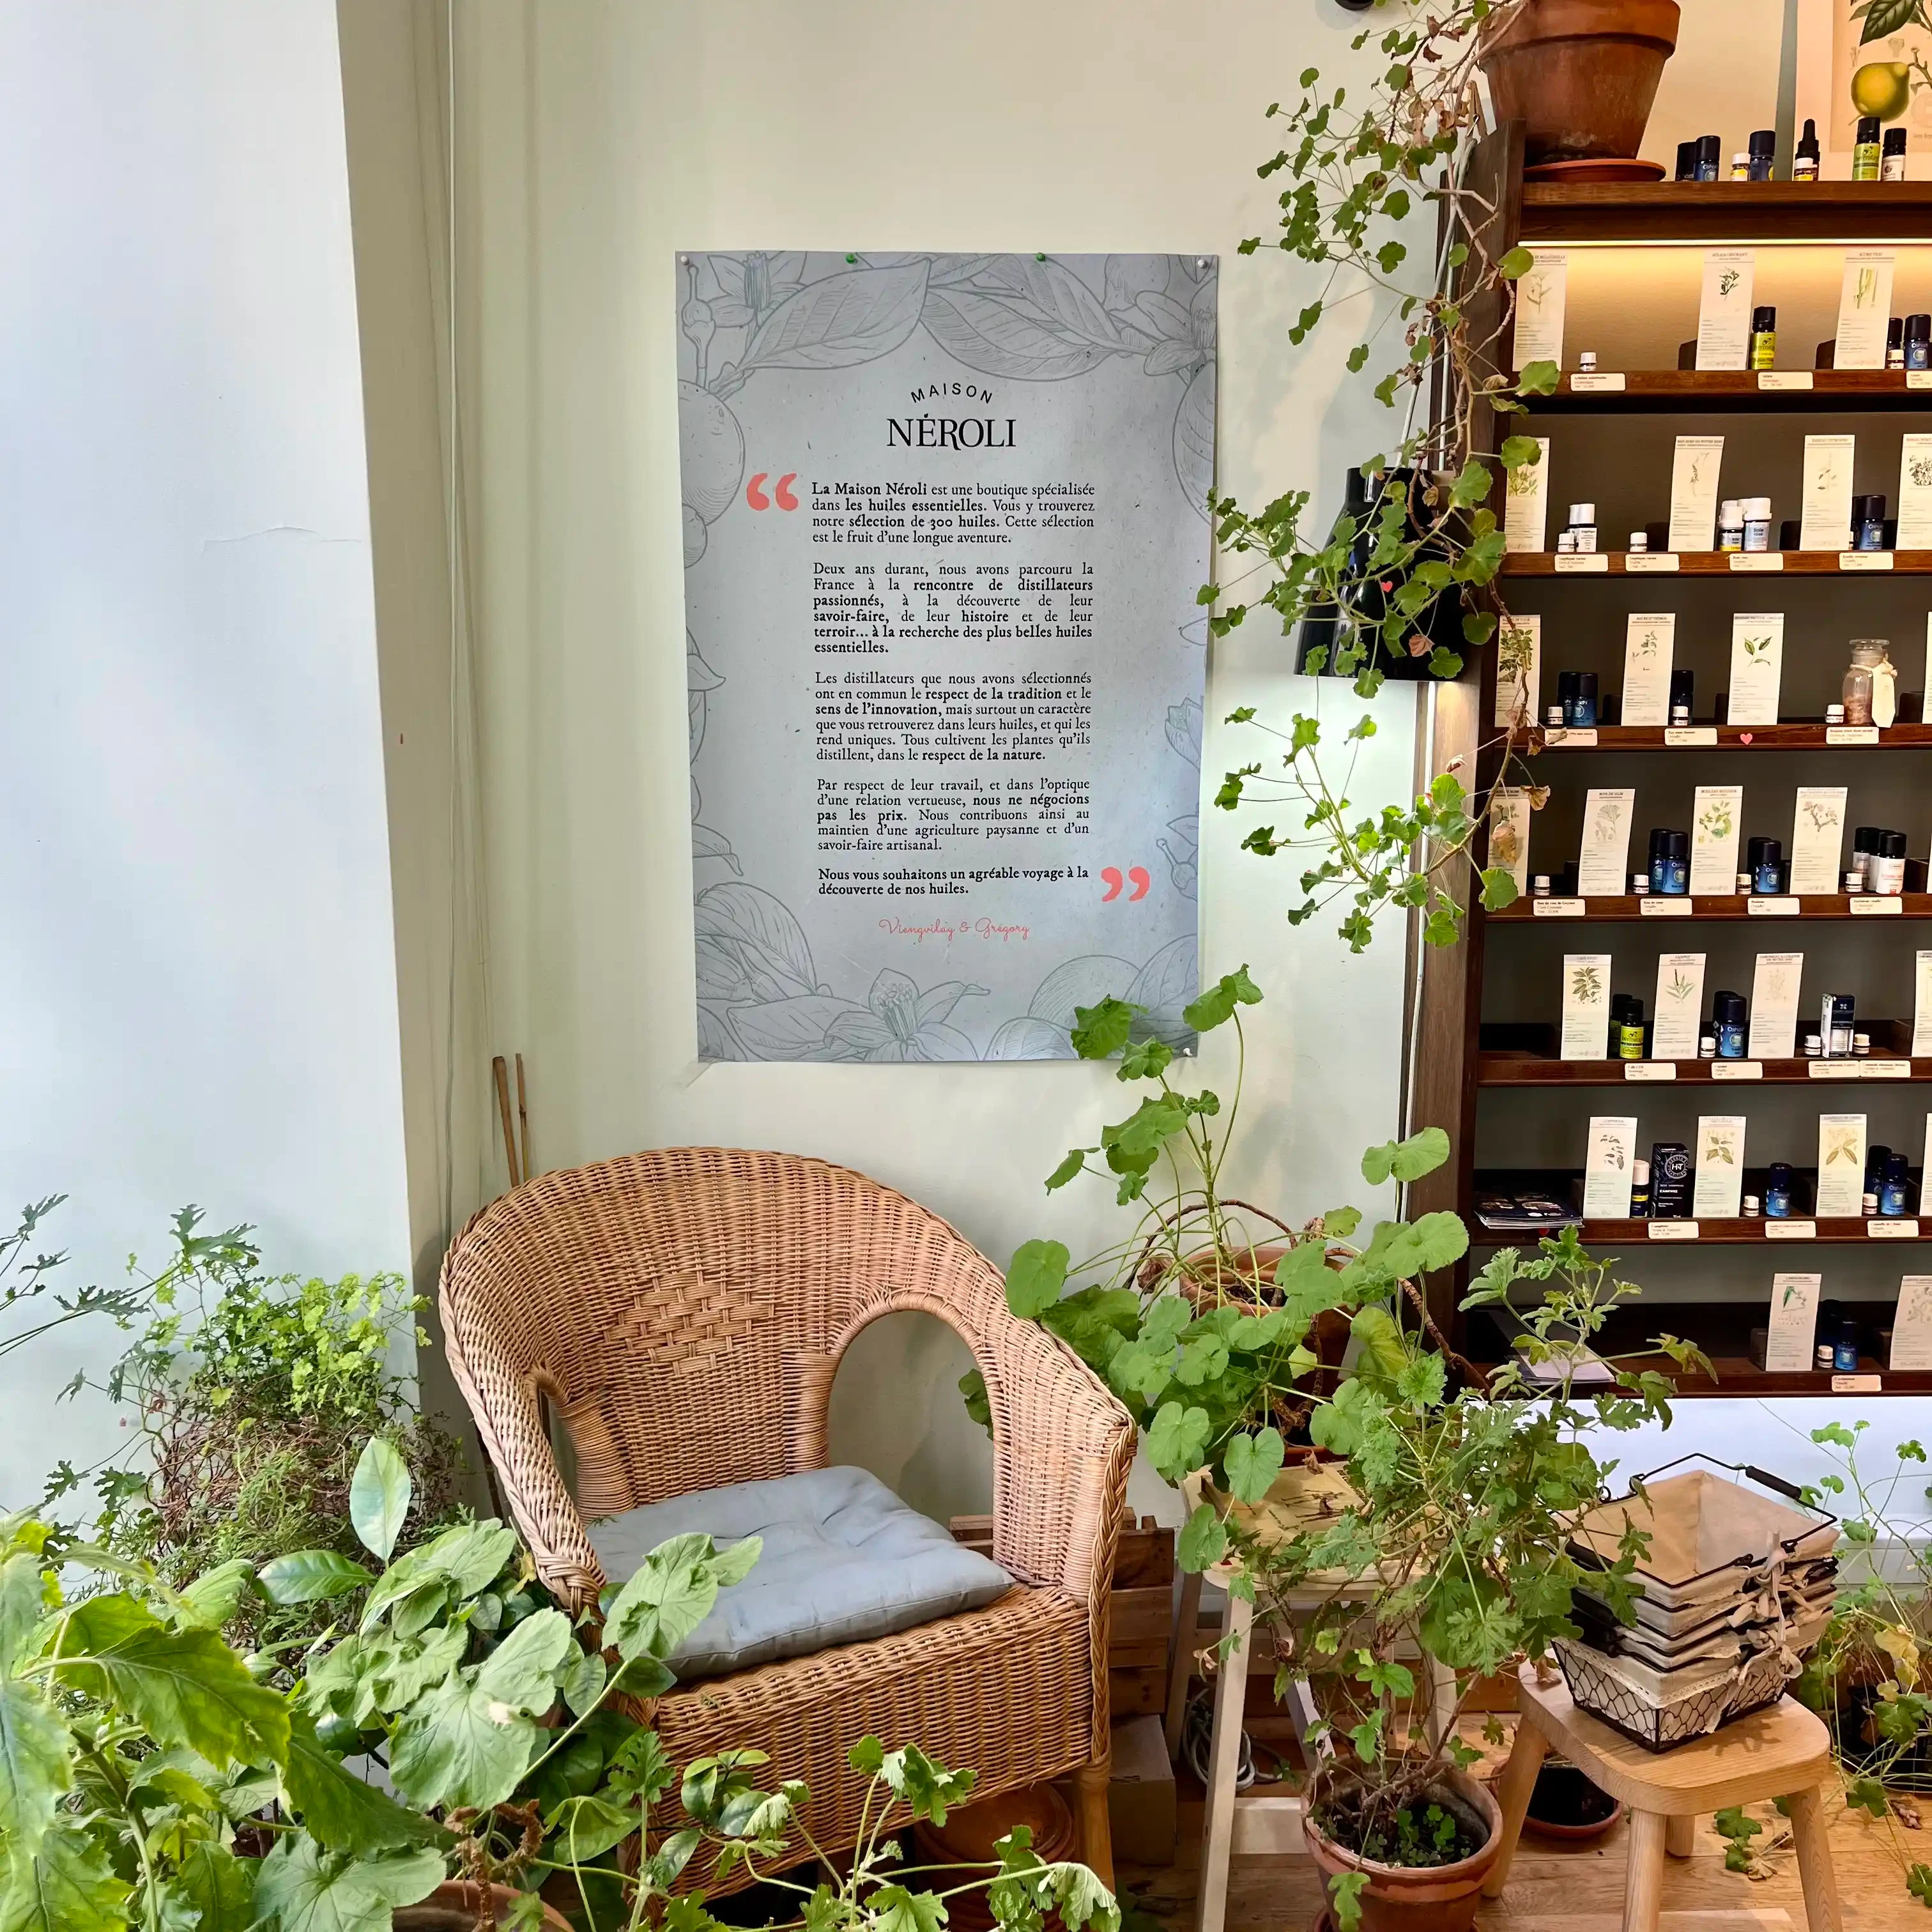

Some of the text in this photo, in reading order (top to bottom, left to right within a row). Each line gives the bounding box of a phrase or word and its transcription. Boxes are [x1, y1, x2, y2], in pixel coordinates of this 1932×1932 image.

[910, 382, 993, 404] MAISON
[886, 412, 1017, 451] NÉROLI
[811, 481, 1095, 500] La Maison Néroli est une boutique spécialisée
[811, 497, 1096, 516] dans les huiles essentielles. Vous y trouverez
[812, 512, 1094, 531] notre sélection de 300 huiles. Cette sélection
[812, 529, 1011, 548] est le fruit d'une longue aventure.
[813, 562, 1094, 578] Deux ans durant, nous avons parcouru la
[813, 576, 1093, 593] France à la rencontre de distillateurs
[813, 592, 1094, 610] passionnés, à la découverte de leur
[813, 608, 1094, 624] savoir-faire, de leur histoire et de leur
[871, 624, 880, 638] à
[882, 624, 896, 638] la
[898, 625, 960, 638] recherche
[963, 625, 983, 638] des
[986, 624, 1012, 642] plus
[1015, 623, 1052, 638] belles
[1055, 624, 1092, 638] huiles
[814, 640, 889, 654] essentielles.
[815, 671, 1092, 689] Les distillateurs que nous avons sélectionnés
[815, 686, 1092, 704] ont en commun le respect de la tradition et le
[815, 701, 1091, 717] sens de l'innovation, mais surtout un caractère
[815, 716, 1091, 734] que vous retrouverez dans leurs huiles, et qui les
[816, 732, 1091, 749] rend uniques. Tous cultivent les plantes qu'ils
[816, 747, 1046, 765] distillent, dans le respect de la nature.
[816, 777, 1090, 795] Par respect de leur travail, et dans l'optique
[817, 793, 1089, 809] d'une relation vertueuse, nous ne négocions
[816, 808, 1089, 825] pas les prix. Nous contribuons ainsi au
[818, 821, 1089, 839] maintien d'une agriculture paysanne et d'un
[817, 838, 942, 851] savoir-faire artisanal.
[818, 865, 1089, 883] Nous vous souhaitons un agréable voyage à la
[818, 881, 969, 895] découverte de nos huiles.
[959, 921, 972, 933] &
[975, 916, 1031, 942] Grégory
